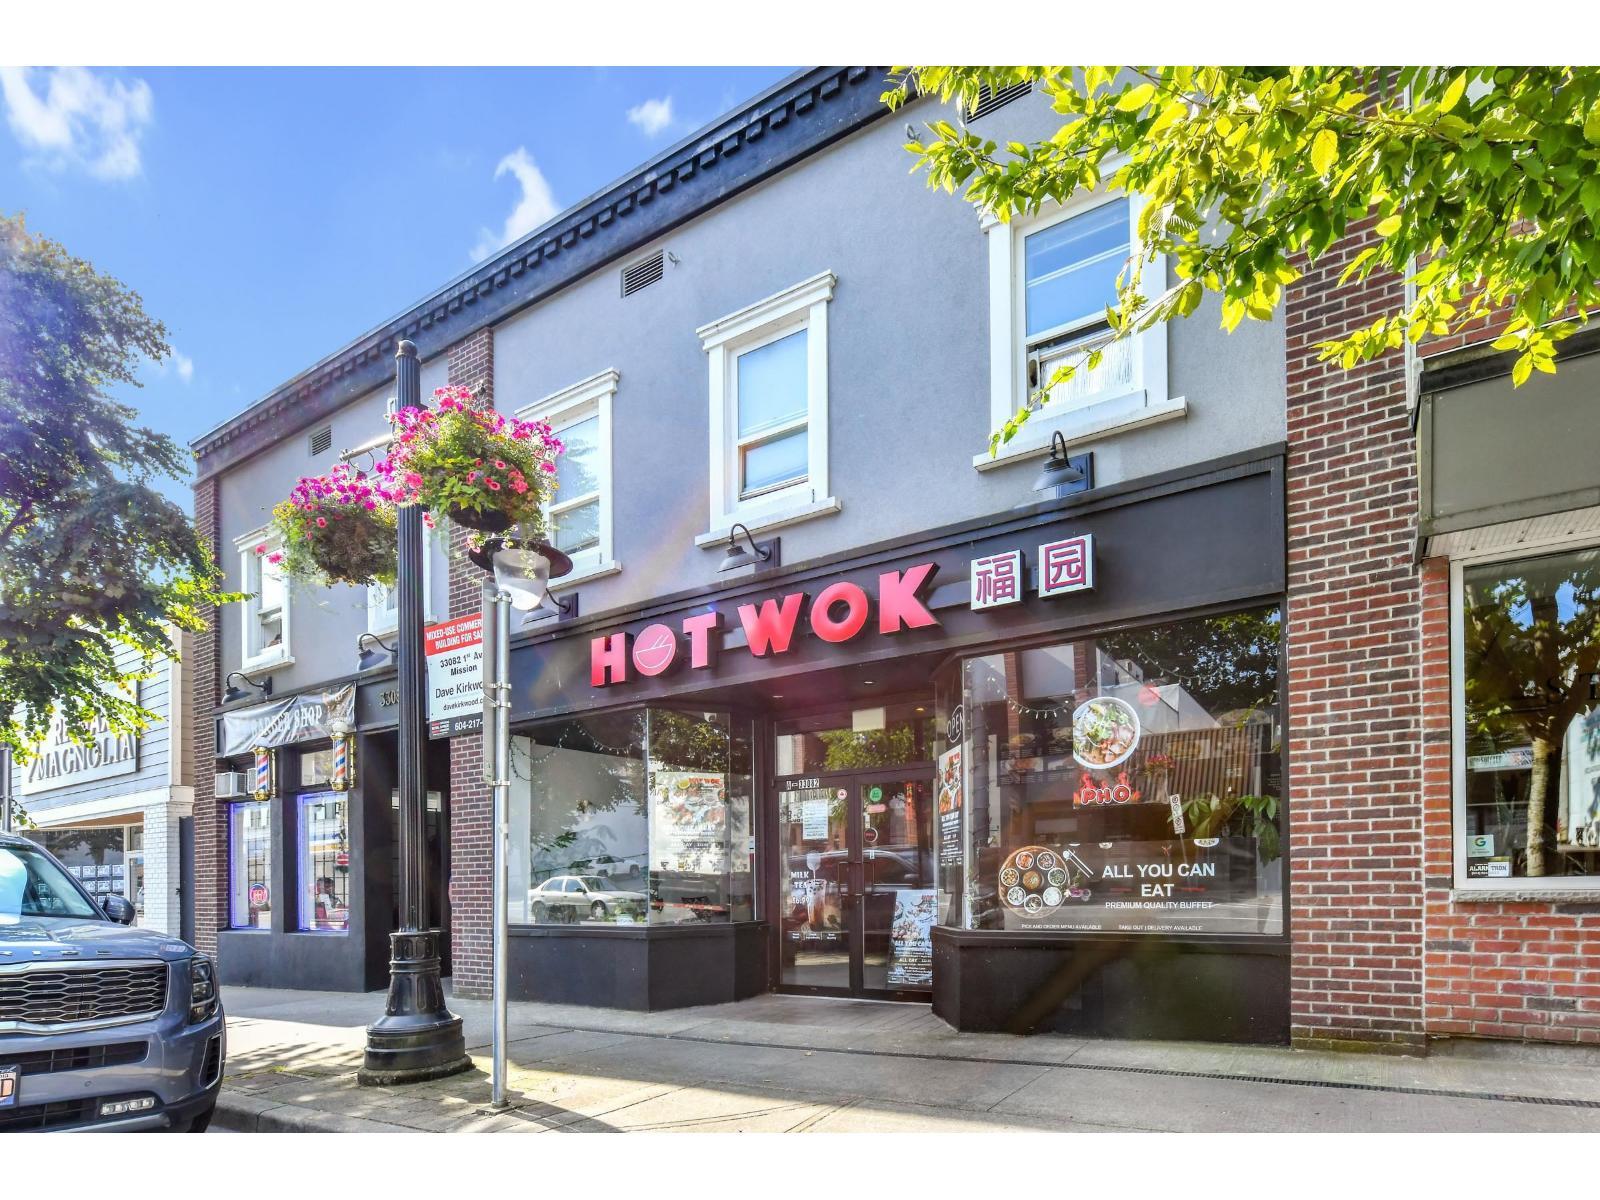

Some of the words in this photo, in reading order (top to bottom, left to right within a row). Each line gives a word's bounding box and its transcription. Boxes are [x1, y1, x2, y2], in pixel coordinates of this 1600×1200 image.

[976, 538, 1086, 604] 福园
[591, 611, 720, 687] HOT
[737, 562, 940, 657] WOK
[426, 625, 456, 640] MIXED-USE
[435, 635, 460, 650] BUILDING
[461, 632, 472, 643] FOR
[440, 656, 461, 668] 33082
[450, 663, 477, 676] Mission
[436, 687, 454, 698] Dave
[294, 705, 322, 729] SHOP
[28, 734, 135, 783] MAGNOLIA
[1081, 784, 1131, 805] PHO
[790, 871, 809, 879] MILK
[1102, 865, 1134, 878] ALL
[1137, 863, 1173, 878] YOU
[1178, 863, 1215, 877] CAN
[1141, 883, 1174, 897] EAT
[1143, 901, 1178, 909] QUALITY
[1180, 901, 1212, 909] BUFFET
